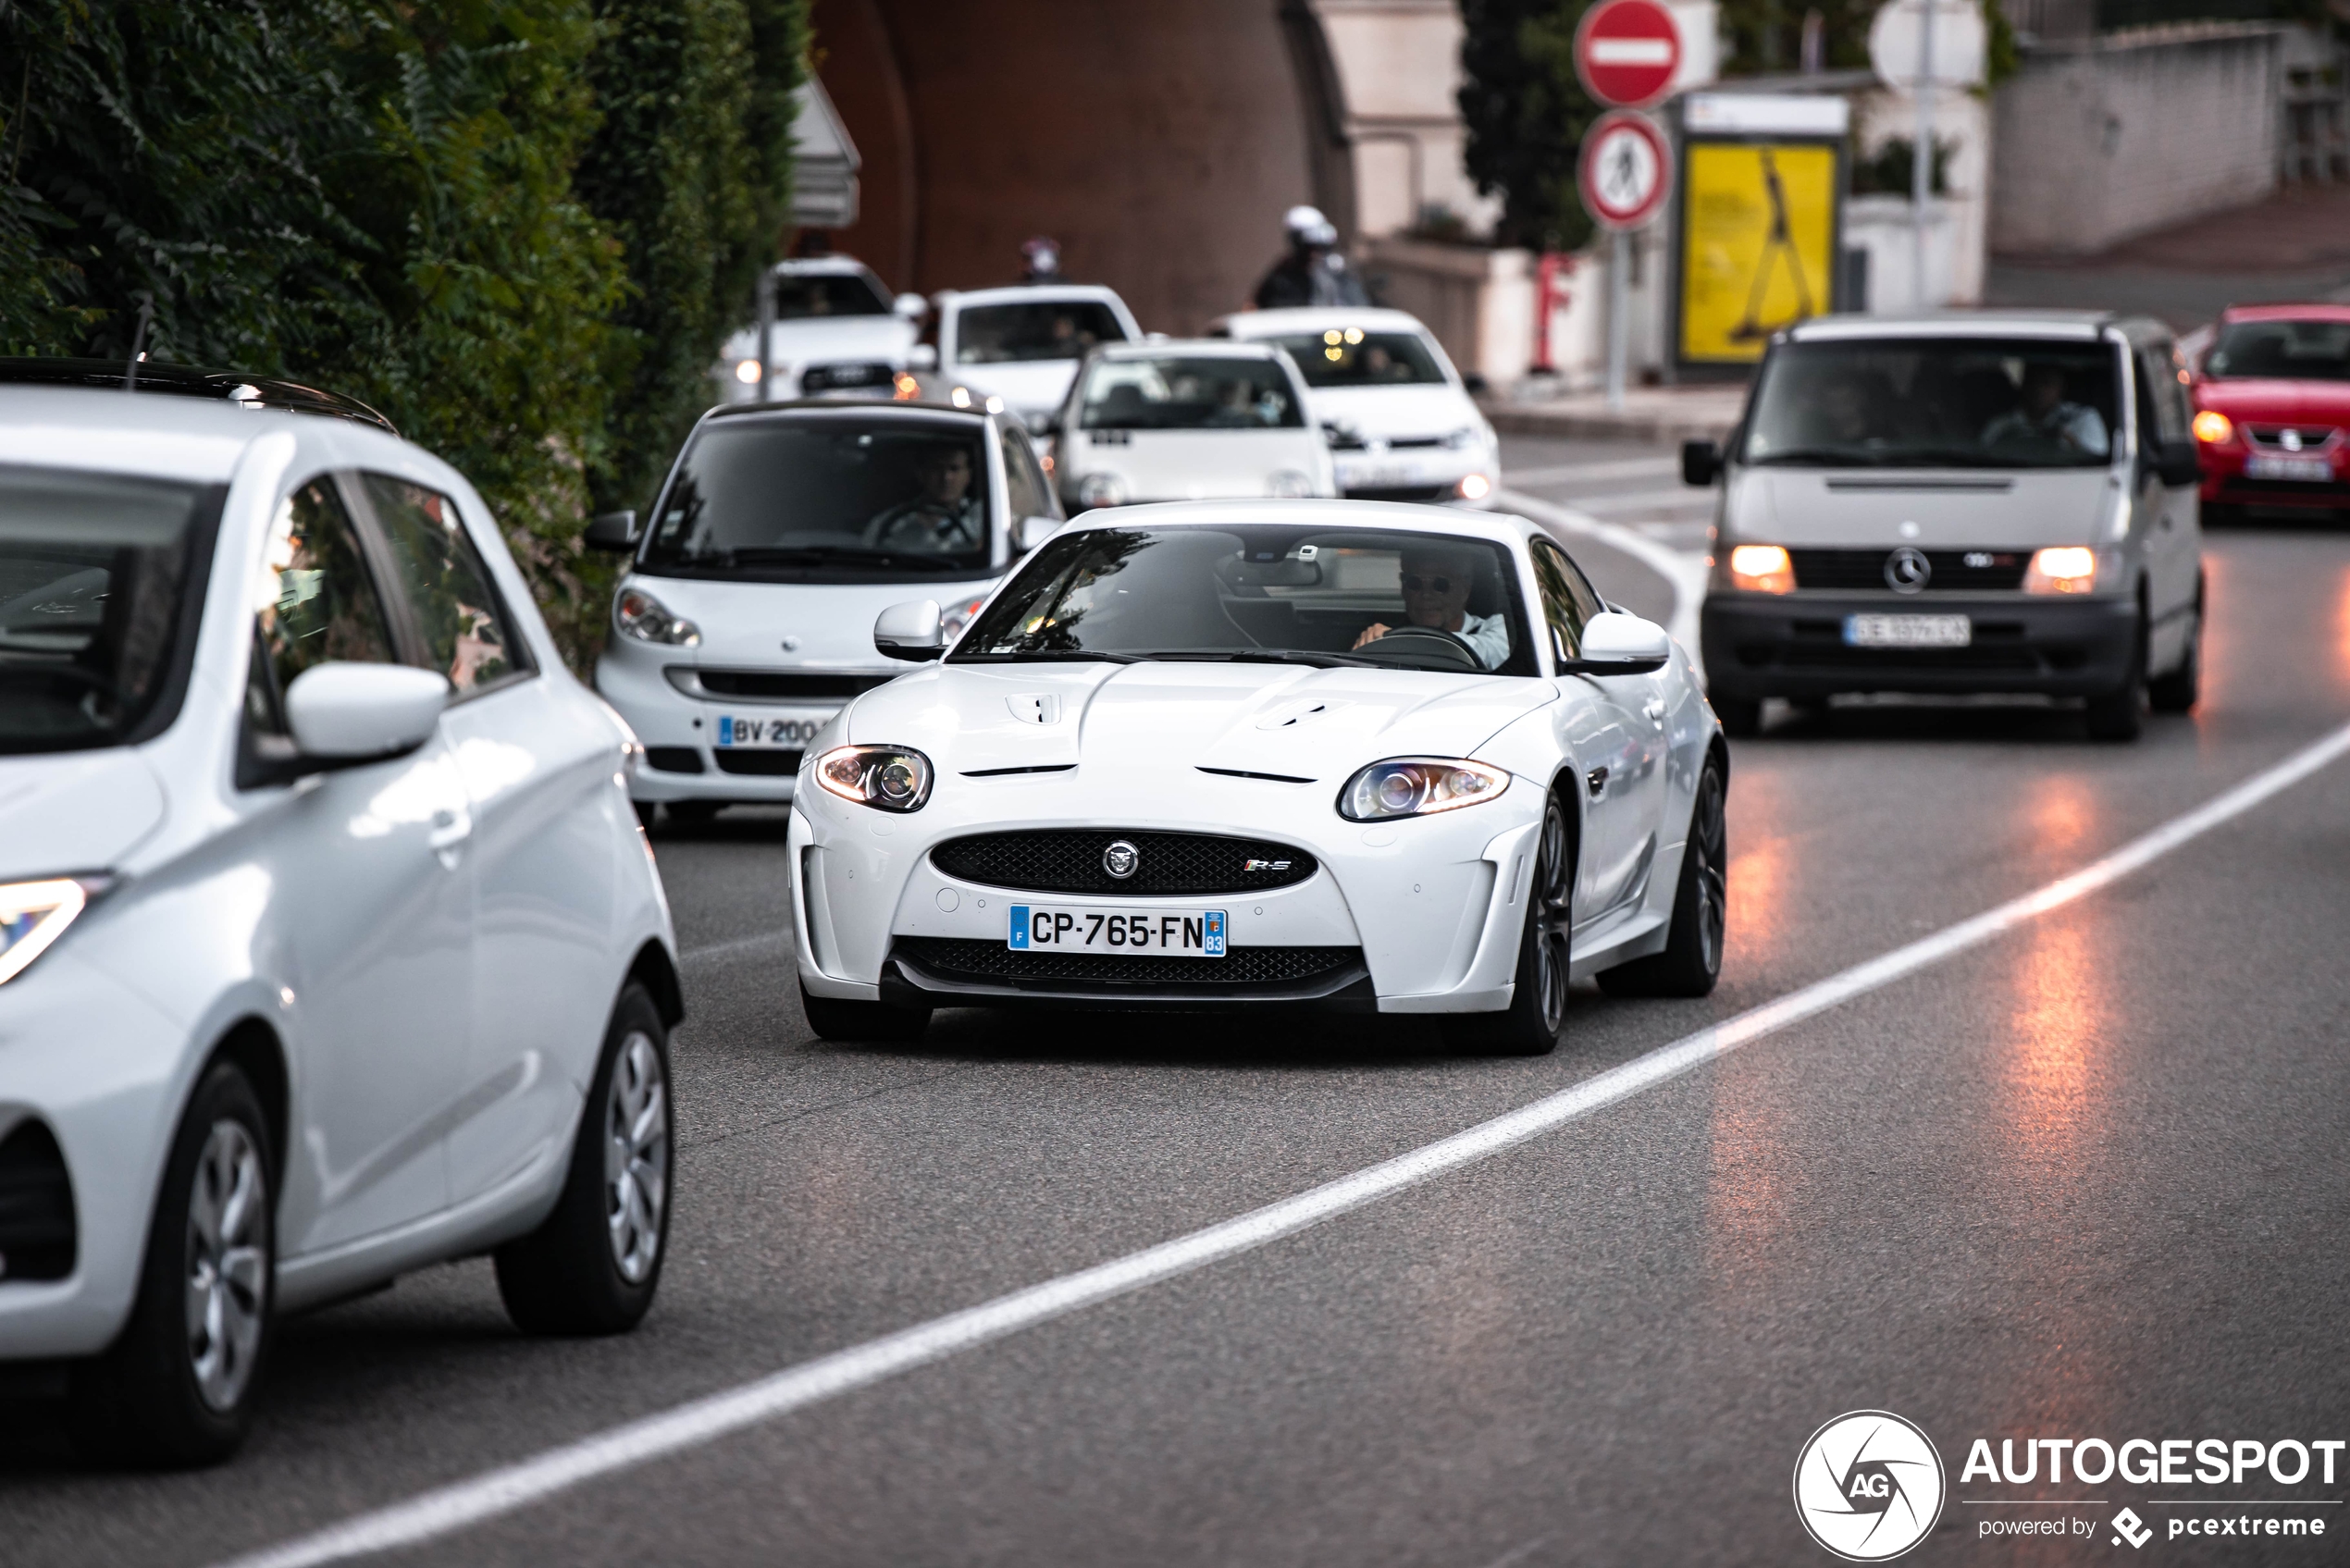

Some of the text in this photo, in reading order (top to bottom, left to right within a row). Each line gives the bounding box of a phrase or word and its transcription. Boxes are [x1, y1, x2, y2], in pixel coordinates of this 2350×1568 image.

[1016, 932, 1023, 942] F
[1033, 912, 1203, 948] CP-765-FN
[1206, 935, 1223, 951] 83
